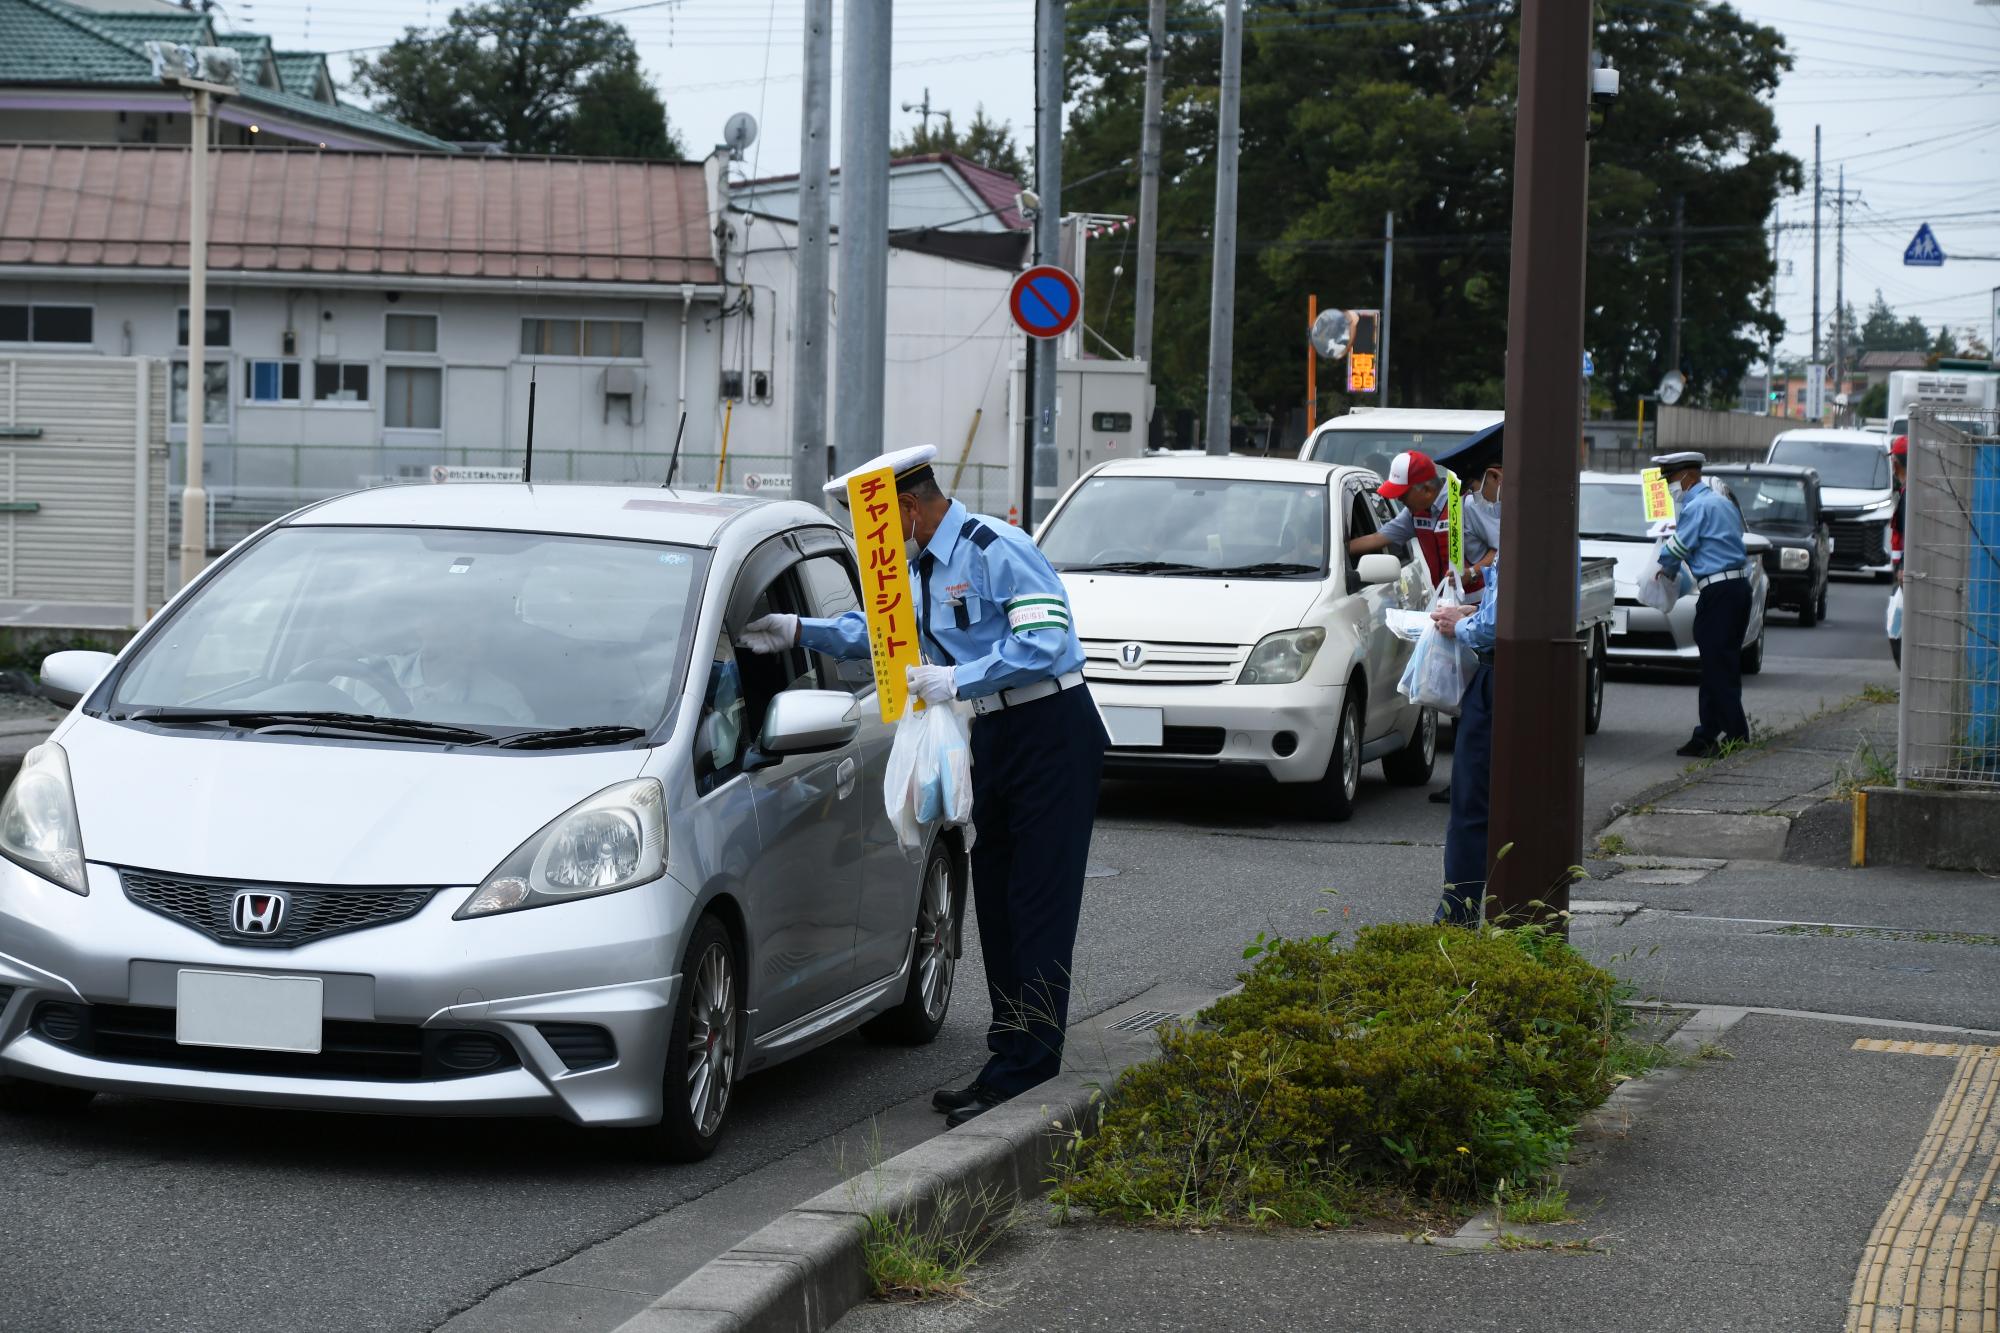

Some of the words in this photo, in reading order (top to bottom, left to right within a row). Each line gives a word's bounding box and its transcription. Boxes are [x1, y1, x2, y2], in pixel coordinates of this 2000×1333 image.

[859, 477, 908, 658] チャイルドシート
